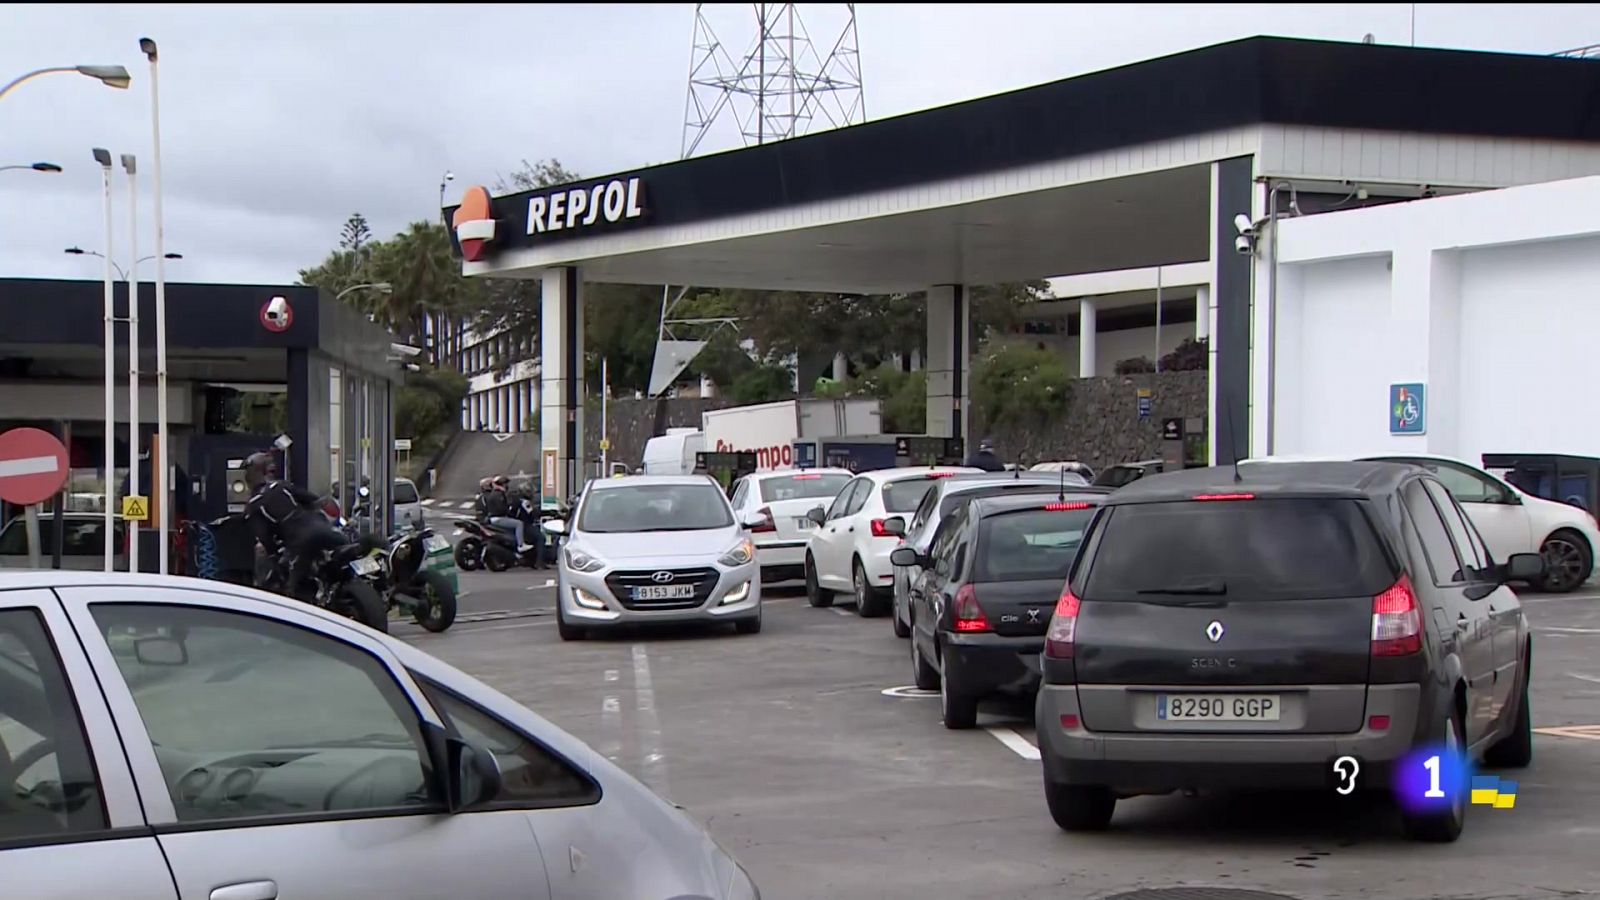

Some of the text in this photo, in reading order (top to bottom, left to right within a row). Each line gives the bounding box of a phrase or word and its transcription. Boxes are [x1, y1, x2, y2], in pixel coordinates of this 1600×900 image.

[527, 178, 641, 235] REPSOL
[641, 587, 667, 598] 8153
[1171, 698, 1273, 717] 8290 GGP
